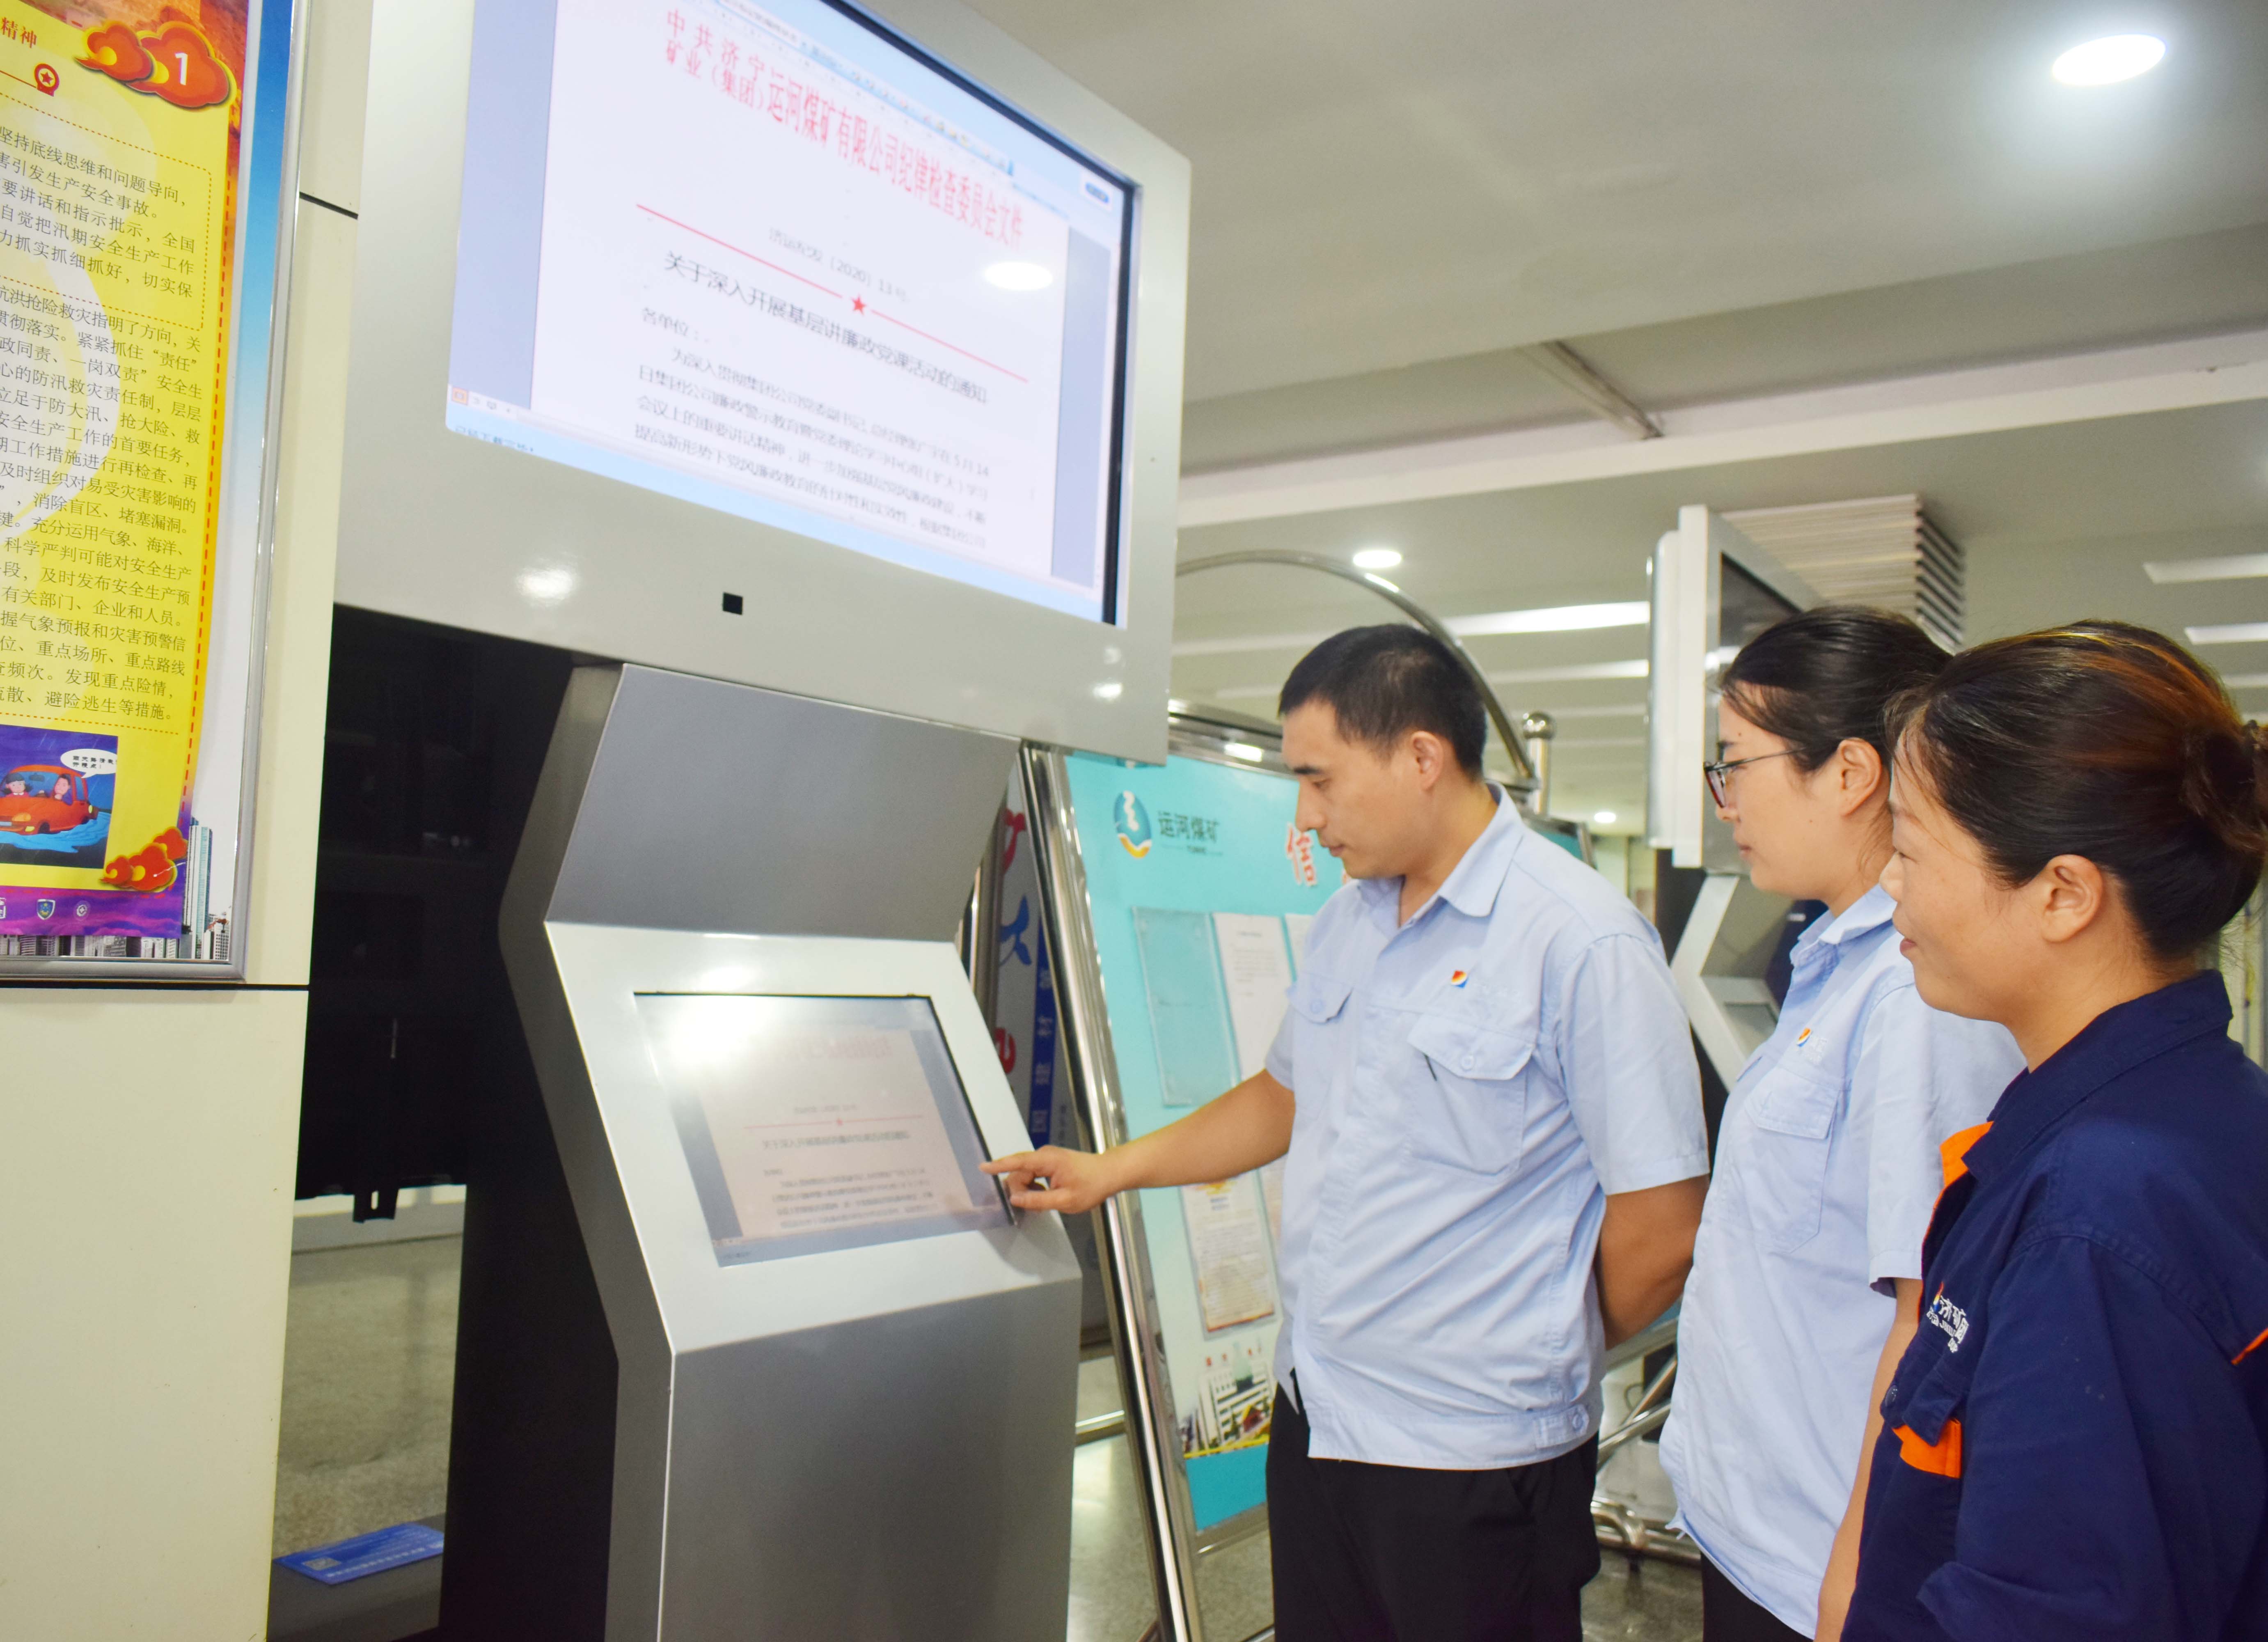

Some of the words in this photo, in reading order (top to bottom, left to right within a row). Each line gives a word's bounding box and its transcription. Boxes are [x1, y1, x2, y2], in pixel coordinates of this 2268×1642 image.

[0, 17, 37, 48] 精神
[175, 53, 188, 86] 1
[2, 204, 194, 275] 自觉把汛期安全生产工作
[0, 461, 196, 514] 及时组织对易受灾害影响的
[0, 610, 186, 652] 握气象预报和灾害预警信
